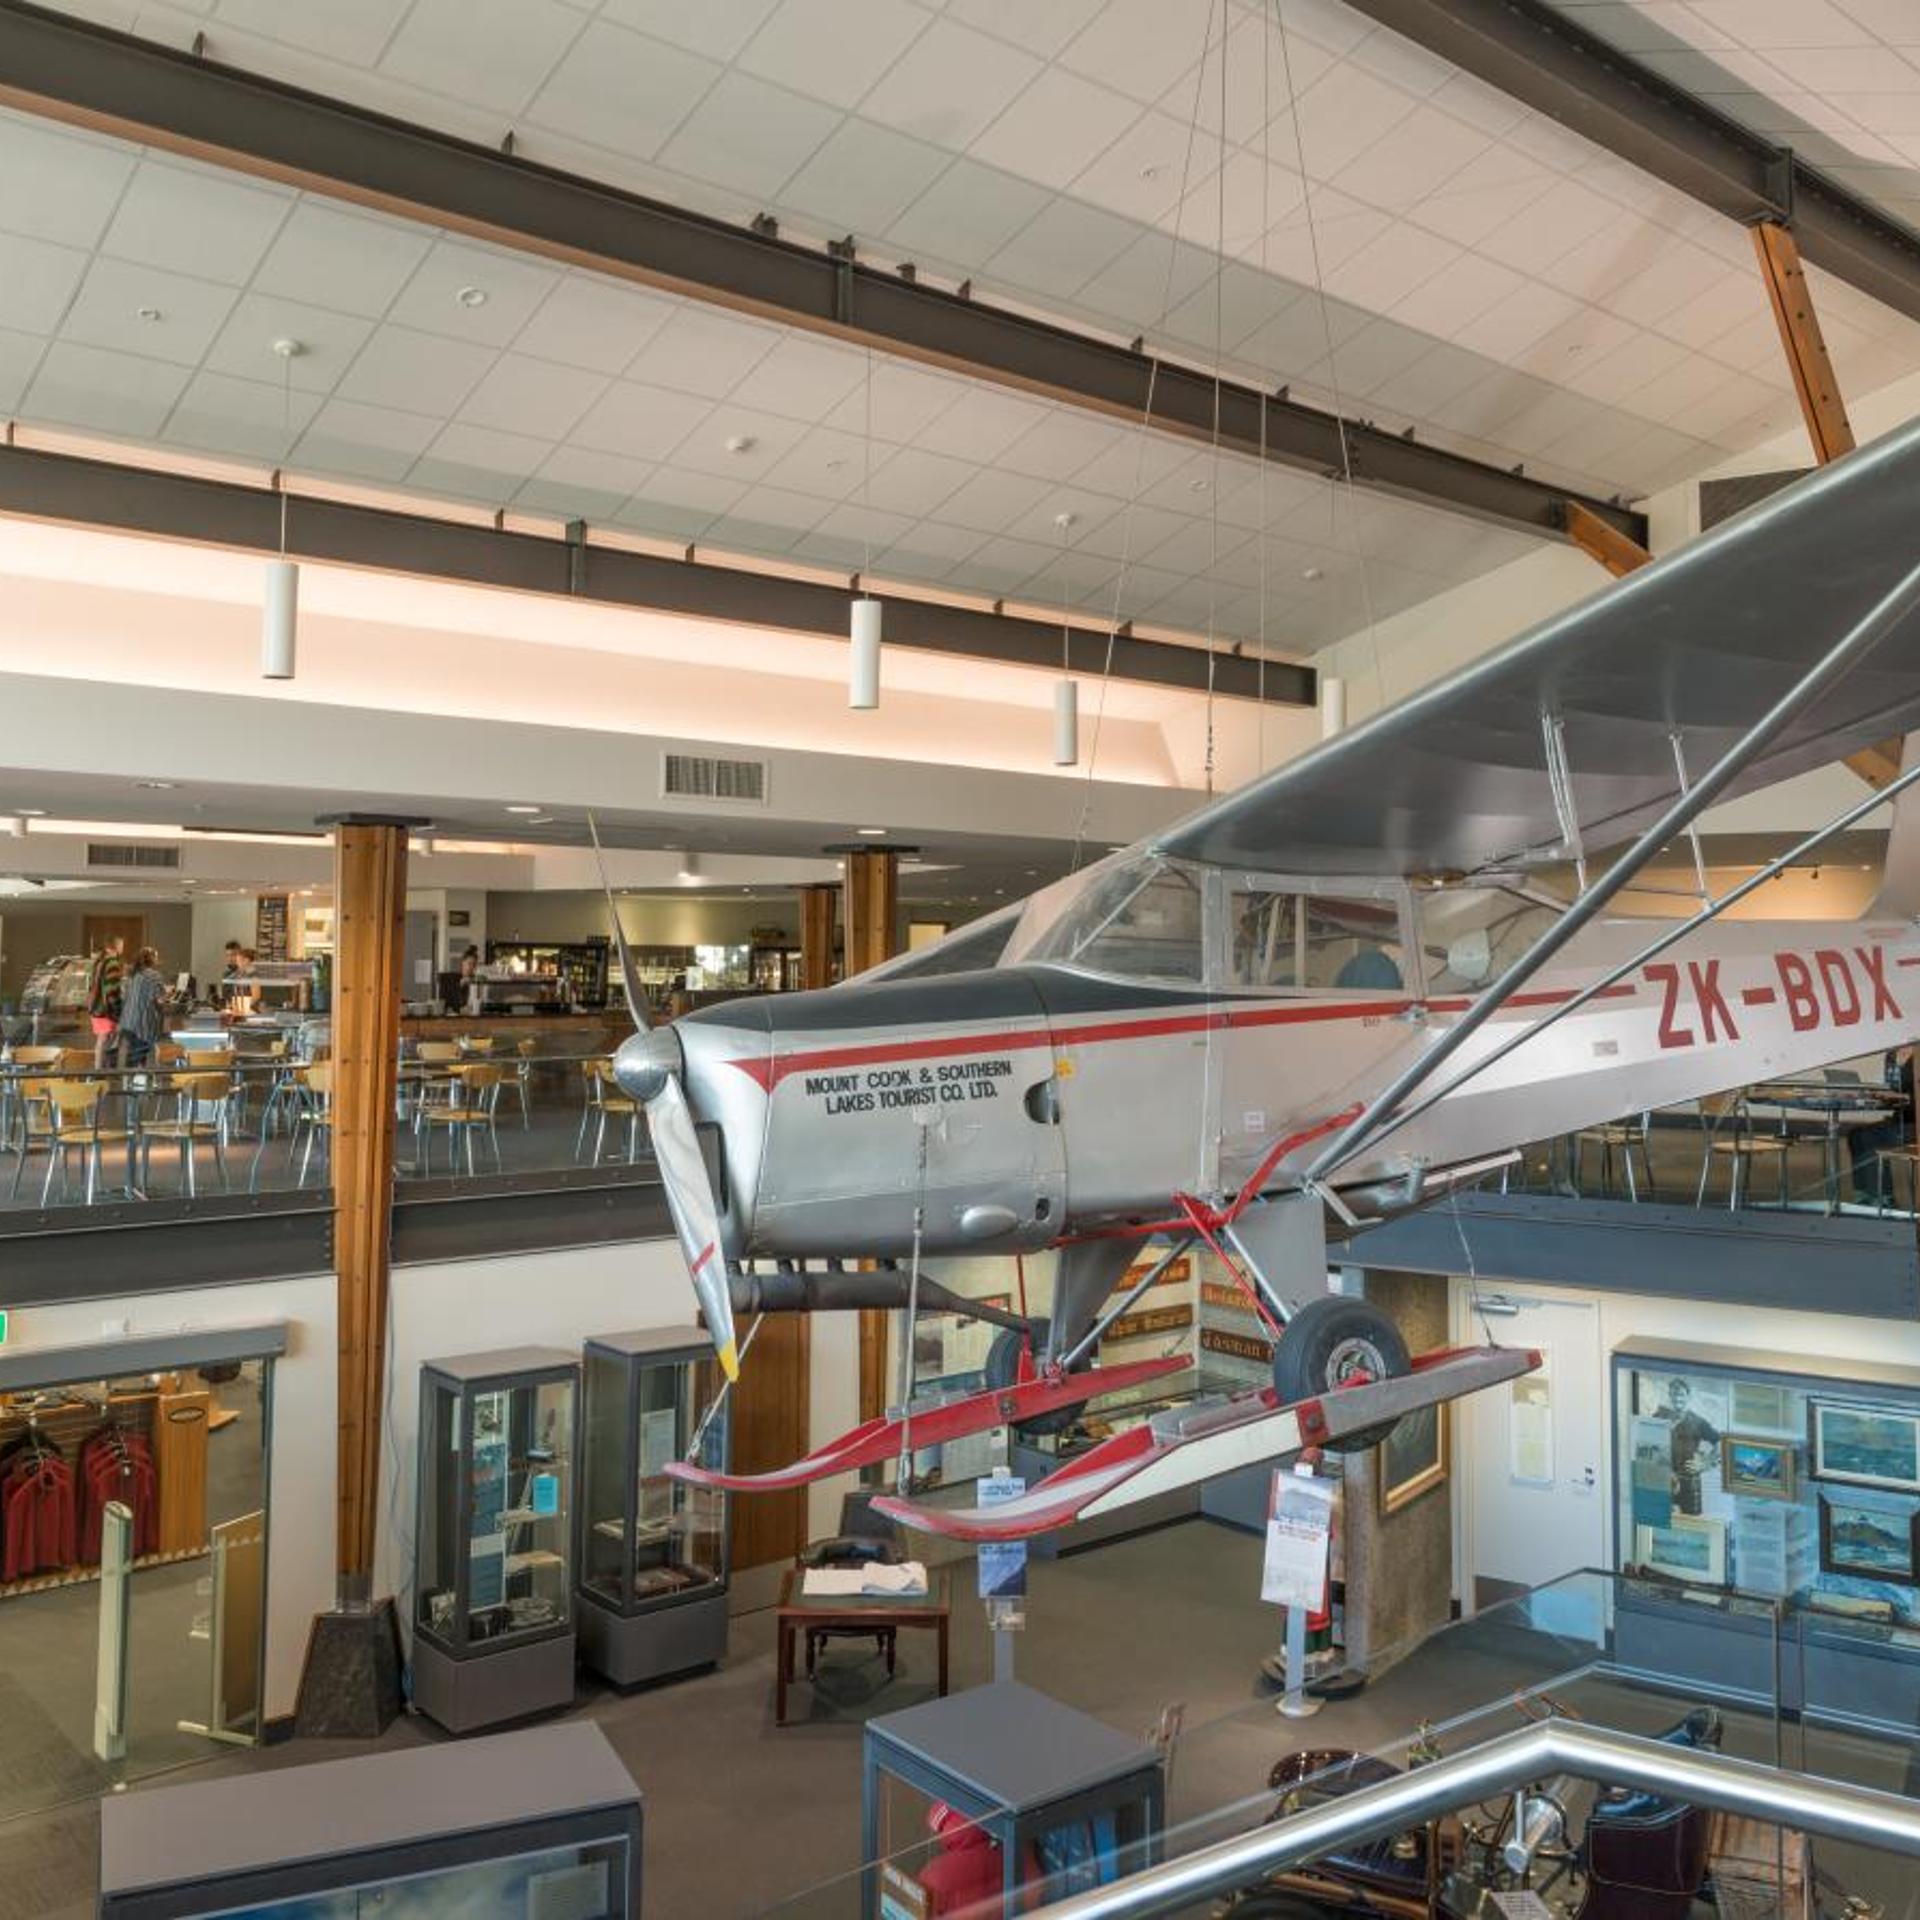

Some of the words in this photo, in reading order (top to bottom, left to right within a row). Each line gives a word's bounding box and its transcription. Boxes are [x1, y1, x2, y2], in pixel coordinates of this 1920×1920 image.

[1642, 946, 1903, 1049] ZK-BDX
[805, 1074, 860, 1096] MOUNT
[919, 1067, 933, 1084] &
[937, 1060, 1013, 1082] SOUTHERN
[825, 1092, 876, 1115] LAKES
[880, 1086, 936, 1109] TOURIST
[940, 1085, 965, 1103] CO.
[969, 1081, 998, 1099] LTD.
